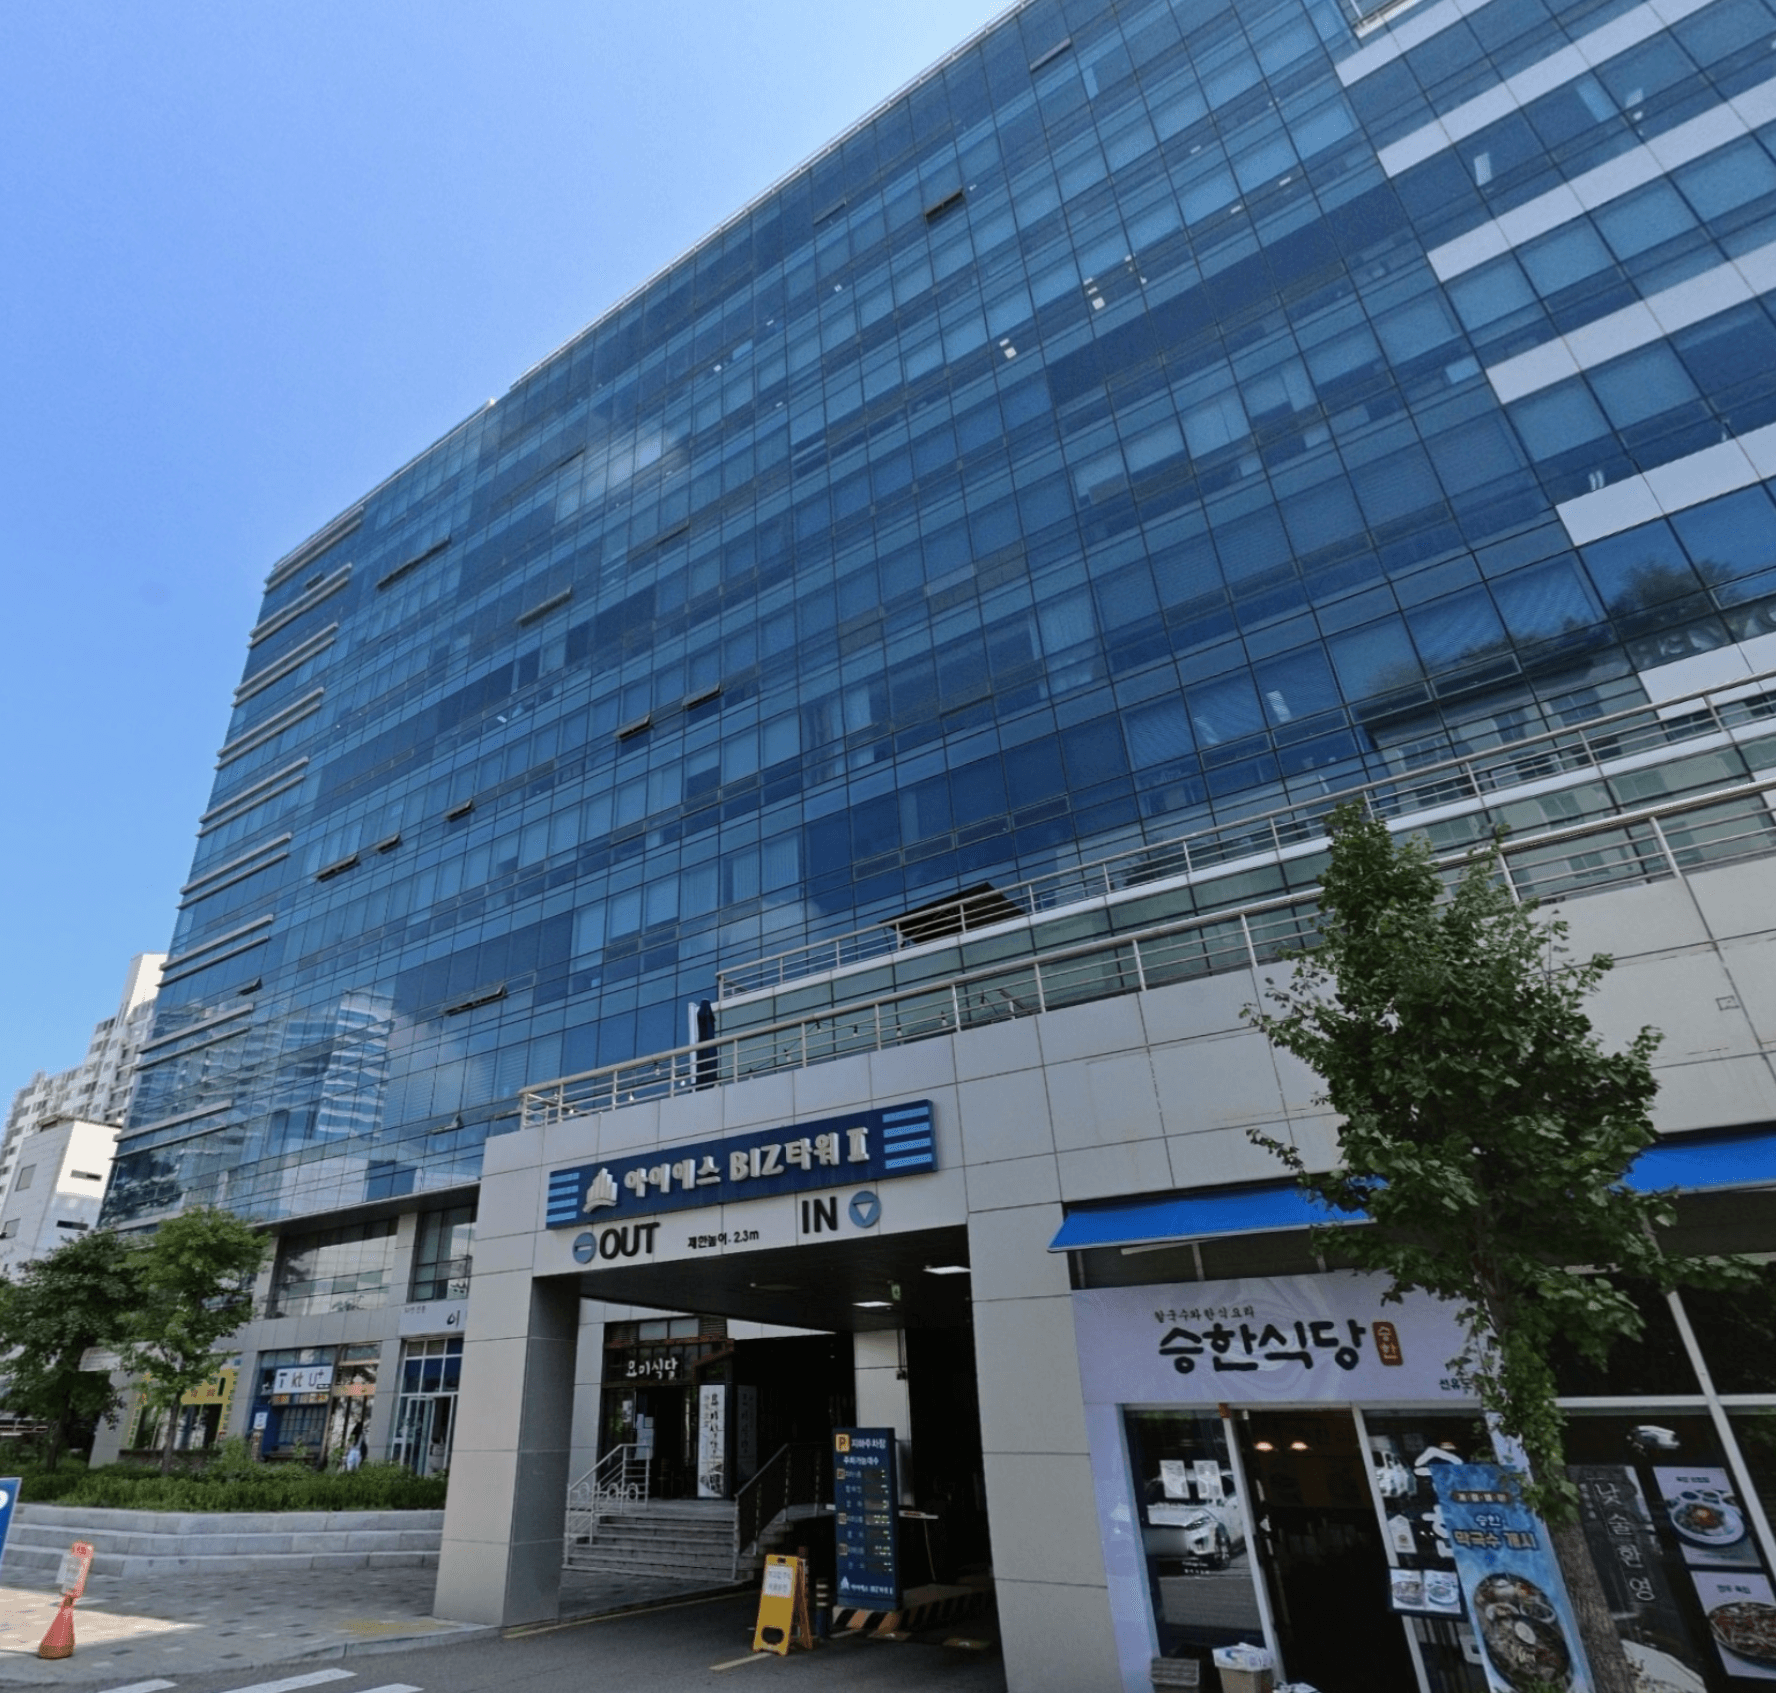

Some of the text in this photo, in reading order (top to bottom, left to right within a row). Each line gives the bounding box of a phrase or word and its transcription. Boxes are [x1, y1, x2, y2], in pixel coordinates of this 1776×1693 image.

[624, 1156, 720, 1197] 아이에스
[729, 1132, 840, 1182] BIZ타워
[801, 1196, 838, 1234] IN
[599, 1222, 660, 1259] OUT
[734, 1230, 759, 1243] 2.3m
[1159, 1320, 1366, 1374] 승한식당
[279, 1369, 324, 1388] T kt U+
[838, 1436, 848, 1450] P
[1453, 1530, 1502, 1548] 막국수
